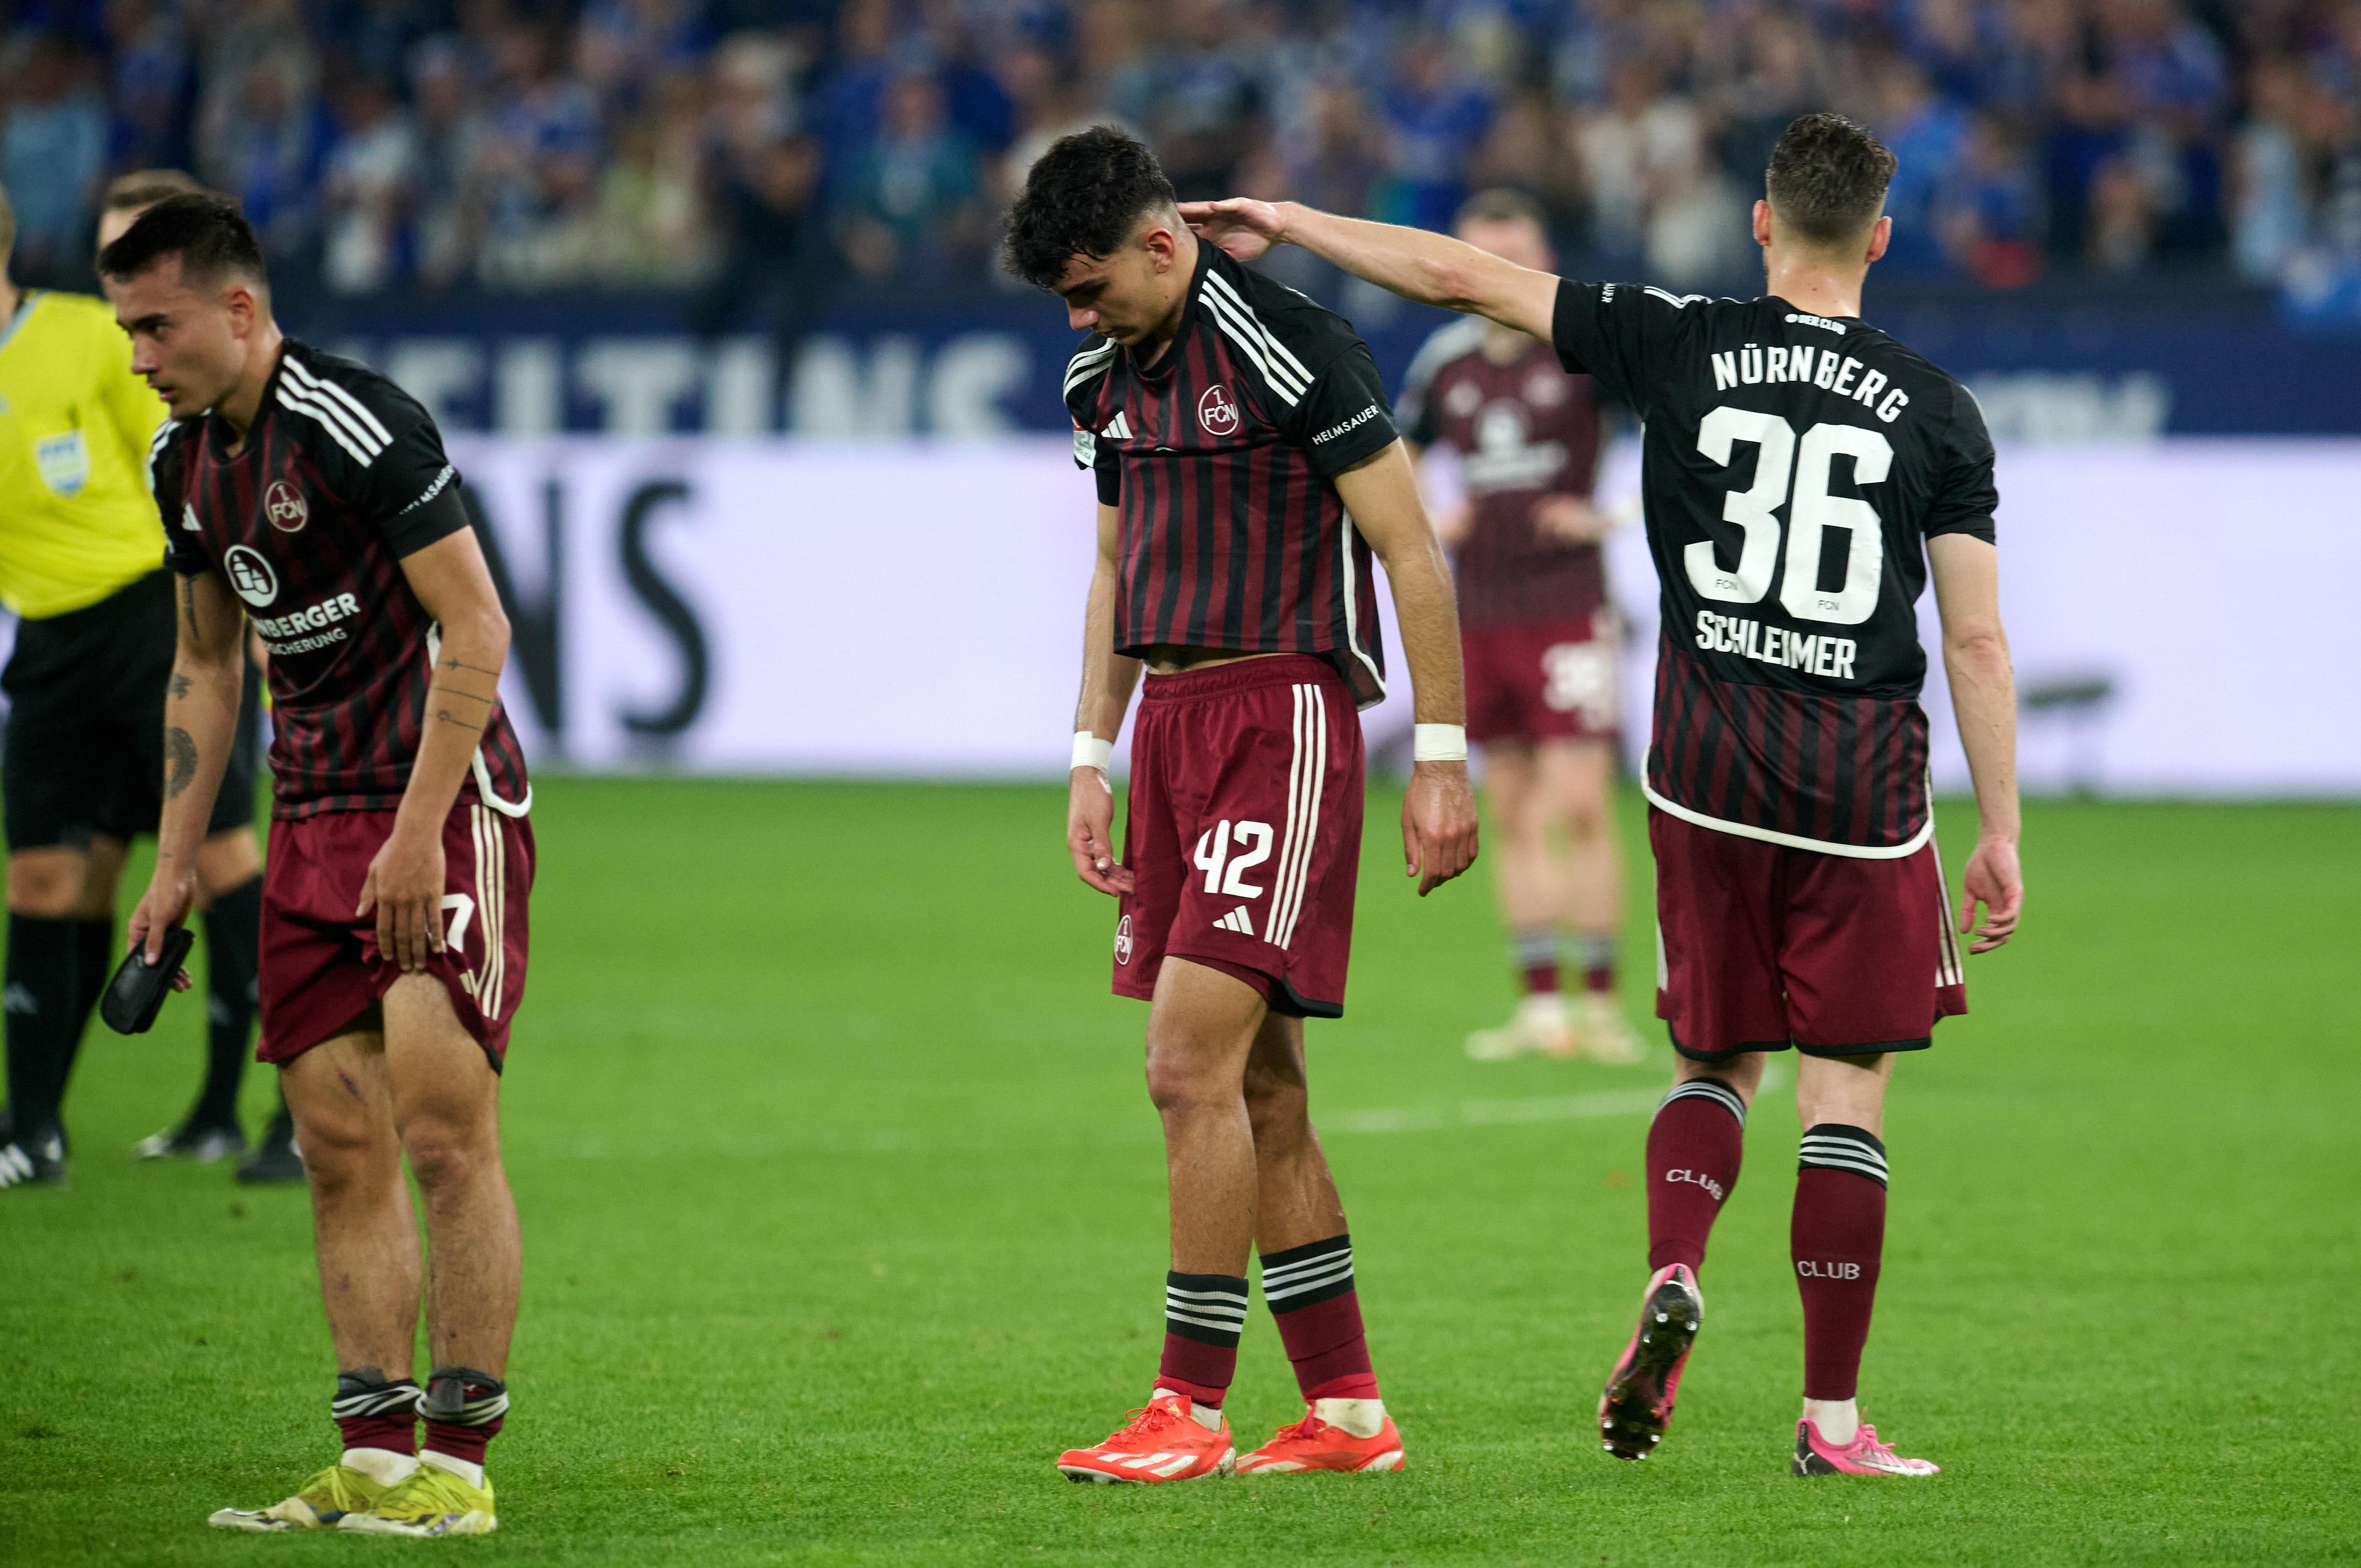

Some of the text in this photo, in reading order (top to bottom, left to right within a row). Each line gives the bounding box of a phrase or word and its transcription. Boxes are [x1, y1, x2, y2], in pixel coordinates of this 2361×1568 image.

[1711, 343, 1909, 423] NÜRNBERG
[1204, 403, 1236, 425] FCN
[1312, 405, 1379, 445] HELMSAUER
[271, 500, 305, 522] FCN
[1684, 406, 1894, 625] 36
[1715, 579, 1739, 591] FCN
[1817, 600, 1840, 611] FCN
[1695, 610, 1857, 680] SCHLEIMER
[1193, 820, 1274, 899] 42
[1116, 935, 1131, 954] FCN
[1666, 1169, 1723, 1200] CLUB
[1797, 1261, 1860, 1280] CLUB
